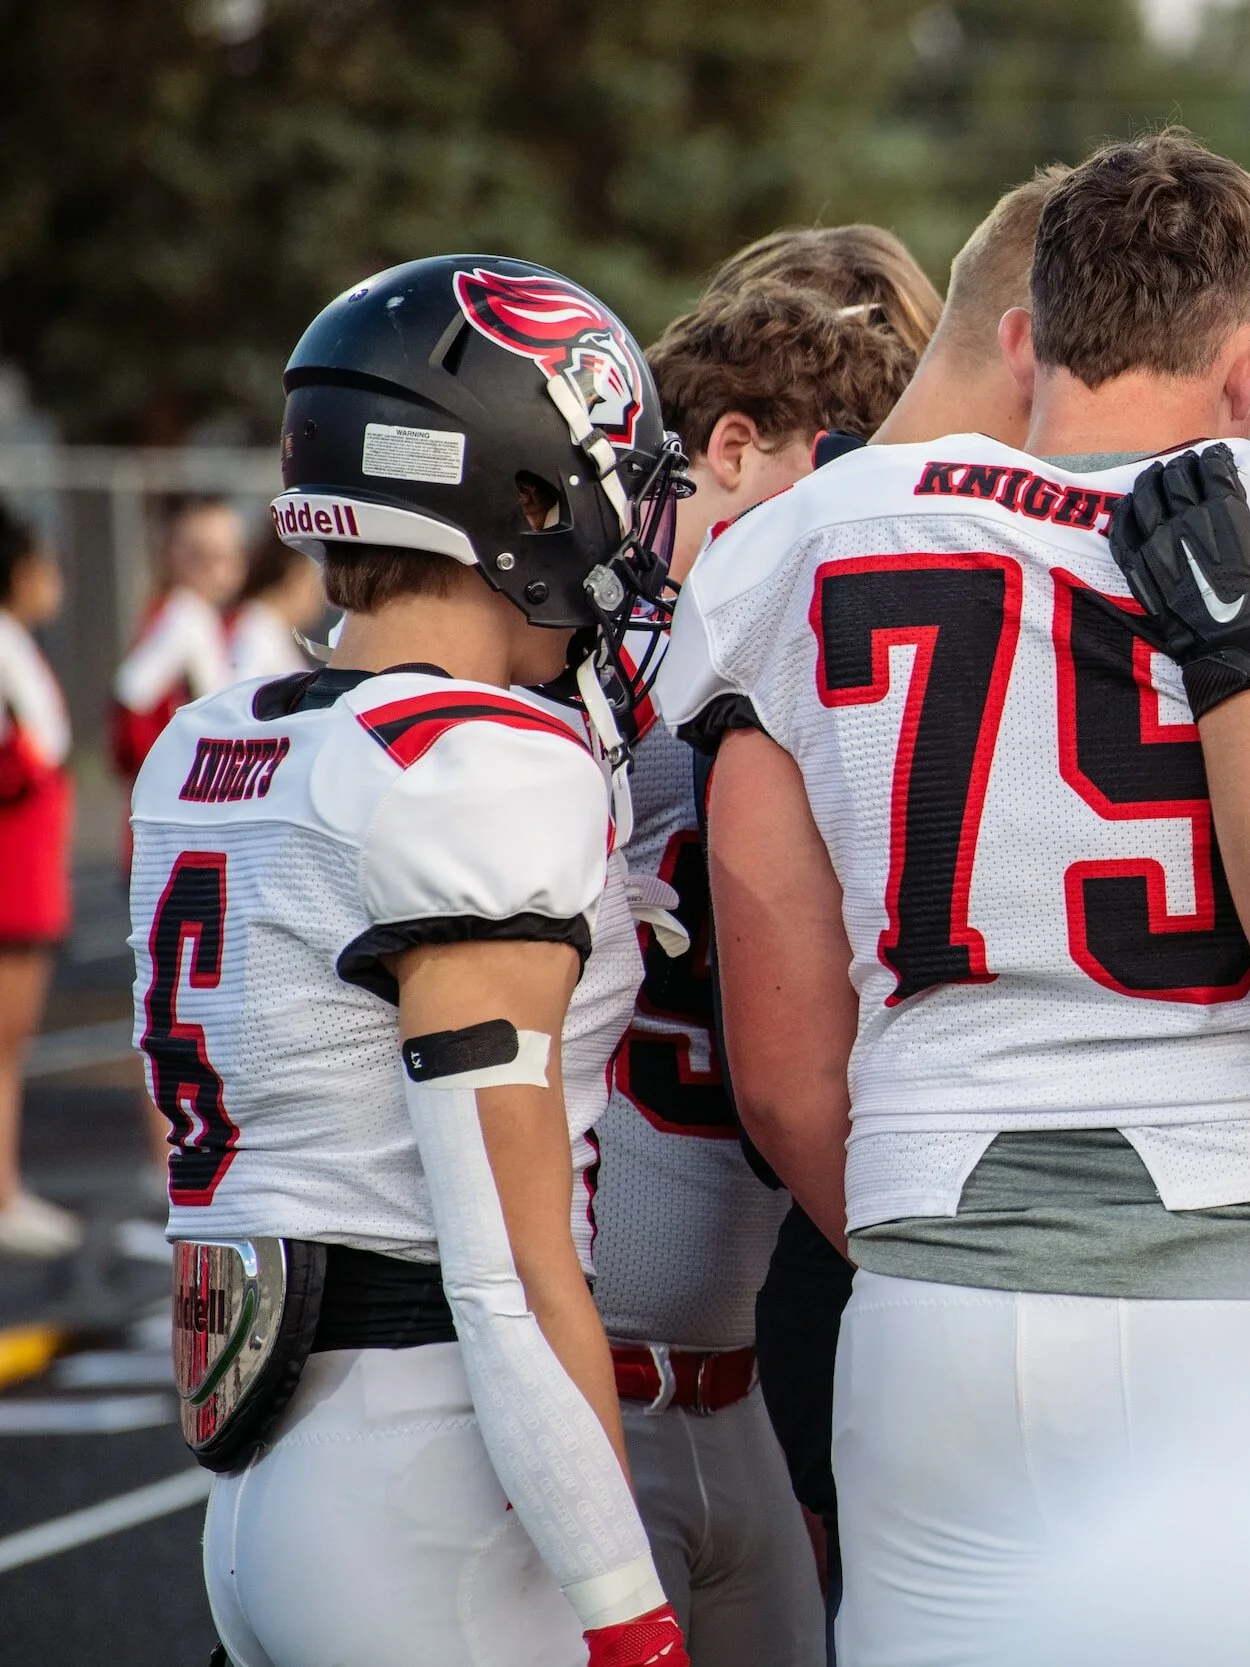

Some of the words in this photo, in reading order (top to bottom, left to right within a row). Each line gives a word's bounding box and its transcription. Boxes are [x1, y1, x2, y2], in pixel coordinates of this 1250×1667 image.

[396, 429, 430, 439] WARNING
[914, 461, 1126, 538] KNIGHT
[179, 737, 290, 802] KNIGHTS
[145, 851, 240, 1206] 6
[411, 1051, 422, 1069] KT
